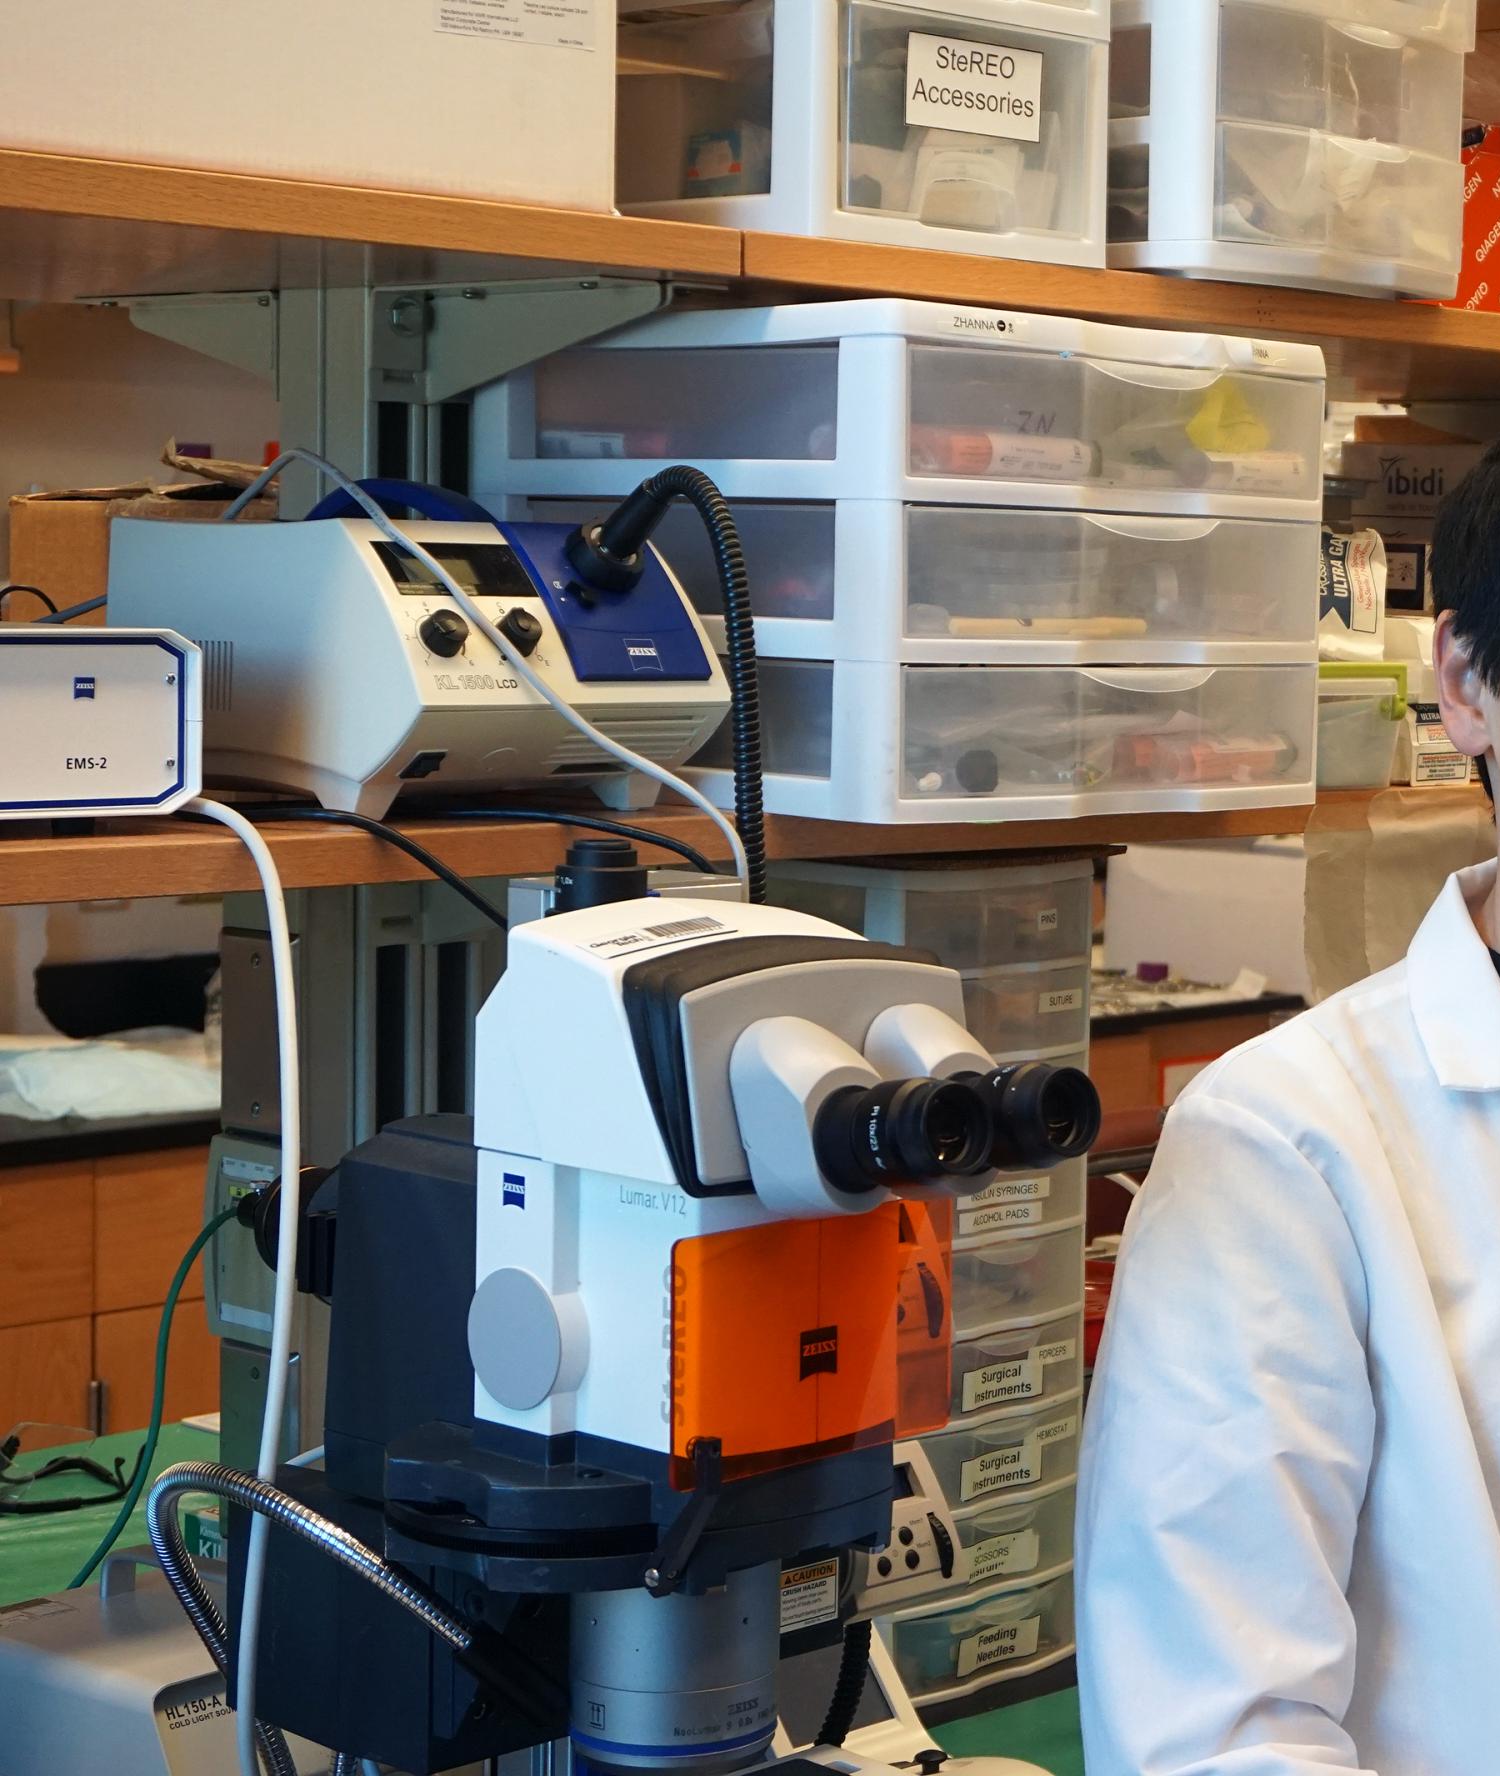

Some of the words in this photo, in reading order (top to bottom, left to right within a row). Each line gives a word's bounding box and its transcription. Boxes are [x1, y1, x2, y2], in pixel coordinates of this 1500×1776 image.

[936, 45, 1015, 79] SteREO
[912, 77, 1034, 118] Accessories
[953, 316, 996, 332] ZHANNA
[1380, 458, 1444, 496] ibidi
[1333, 560, 1348, 598] ULTRA
[626, 646, 657, 656] ZEISS
[434, 674, 459, 690] KL
[461, 674, 495, 690] 1500
[497, 678, 518, 690] LCD
[1420, 711, 1441, 721] ULTRA
[66, 757, 107, 770] EMS-2
[1040, 912, 1056, 925] PINS
[589, 934, 637, 949] Georgia
[616, 937, 644, 947] Tech
[1049, 993, 1073, 1007] SUTURE
[503, 1182, 525, 1195] ZEISS
[970, 1187, 995, 1202] INSULIN
[996, 1183, 1040, 1198] SYRINGES
[662, 1194, 687, 1216] V12
[973, 1211, 1003, 1226] ALCOHOL
[1006, 1208, 1030, 1219] PADS
[660, 1264, 688, 1427] SteREO
[803, 1340, 836, 1357] ZEISS
[1038, 1344, 1067, 1360] FORCEPS
[981, 1365, 1022, 1385] Surgical
[974, 1382, 1032, 1404] Instruments
[1036, 1423, 1068, 1440] HEMOSTAT
[979, 1451, 1020, 1472] Surgical
[972, 1468, 1031, 1491] Instruments
[974, 1546, 1009, 1567] SCISSORS
[792, 1563, 834, 1584] CAUTION
[782, 1586, 801, 1597] CRUSH
[802, 1580, 827, 1592] HAZARD
[978, 1627, 1017, 1648] Feeding
[976, 1644, 1015, 1665] Needles
[165, 1694, 223, 1721] HL150-A
[169, 1717, 191, 1730] COLD
[191, 1711, 215, 1725] LIGHT
